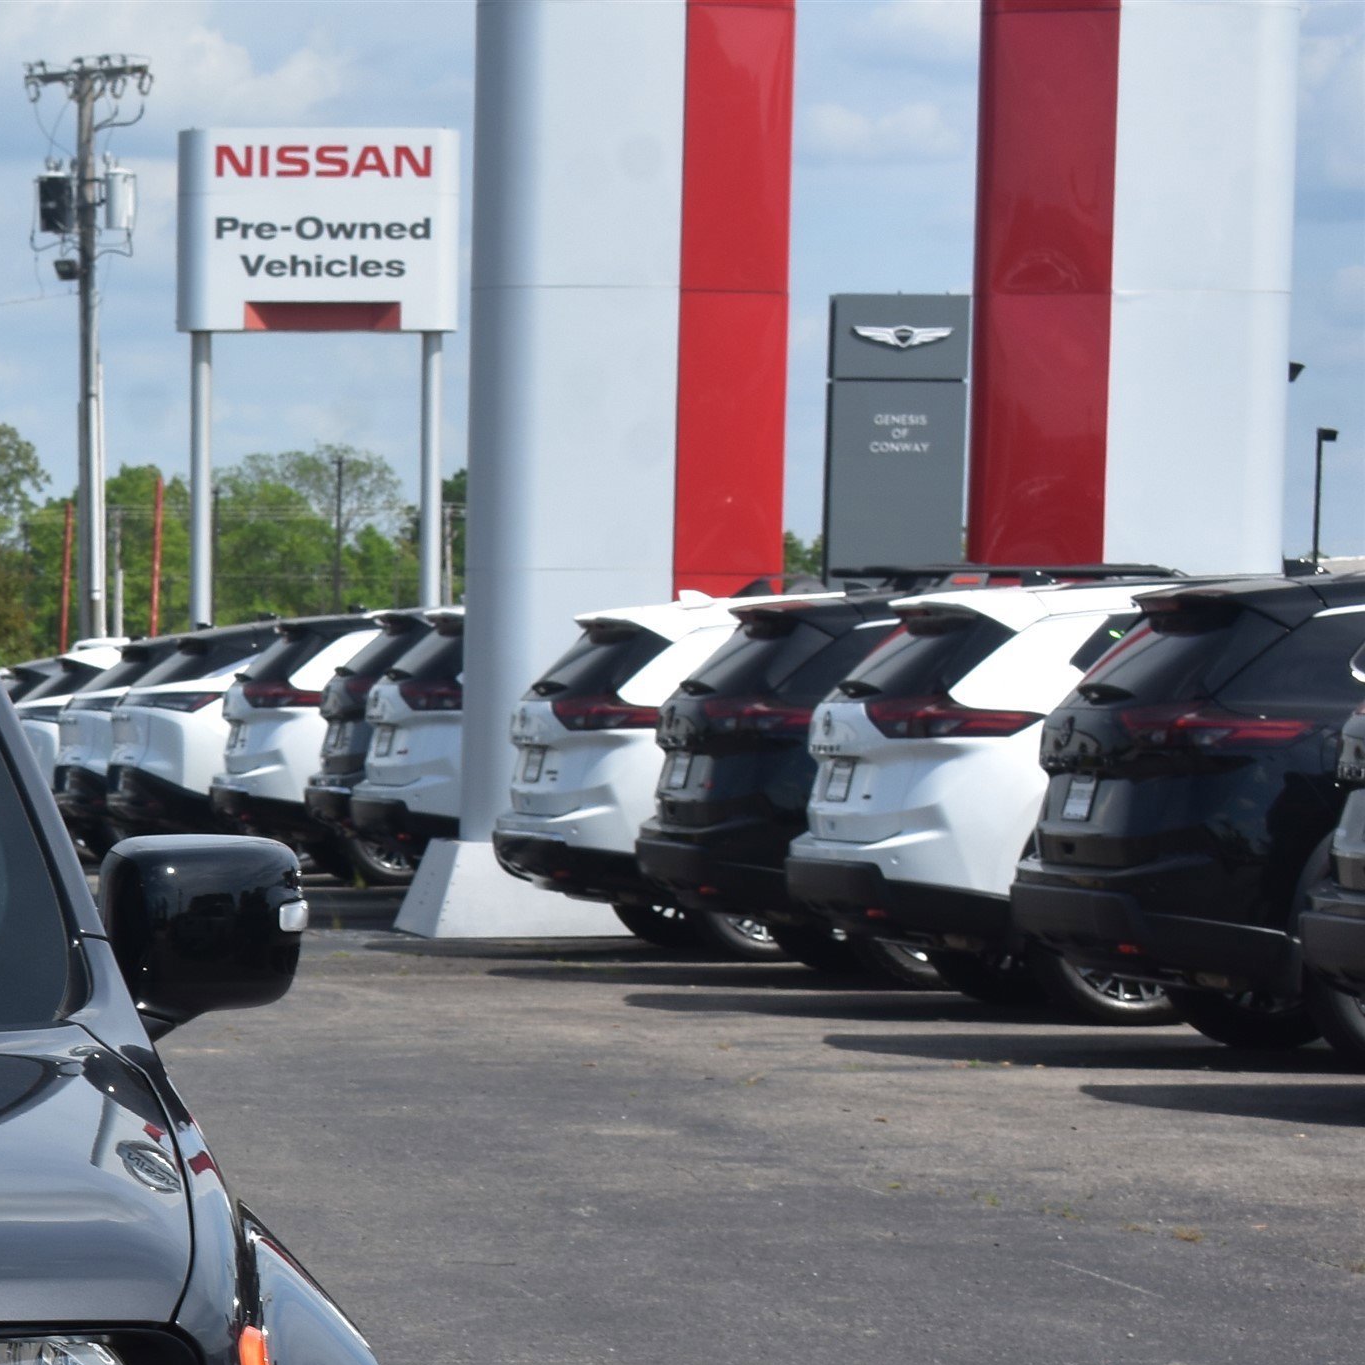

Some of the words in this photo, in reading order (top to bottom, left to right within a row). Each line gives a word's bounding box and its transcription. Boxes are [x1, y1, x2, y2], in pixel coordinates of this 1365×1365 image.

[215, 145, 431, 177] NISSAN
[215, 216, 431, 240] Pre-Owned
[240, 255, 406, 278] Vehicles
[874, 414, 927, 425] GENESIS
[892, 429, 908, 439] OF
[870, 442, 929, 453] CONWAY
